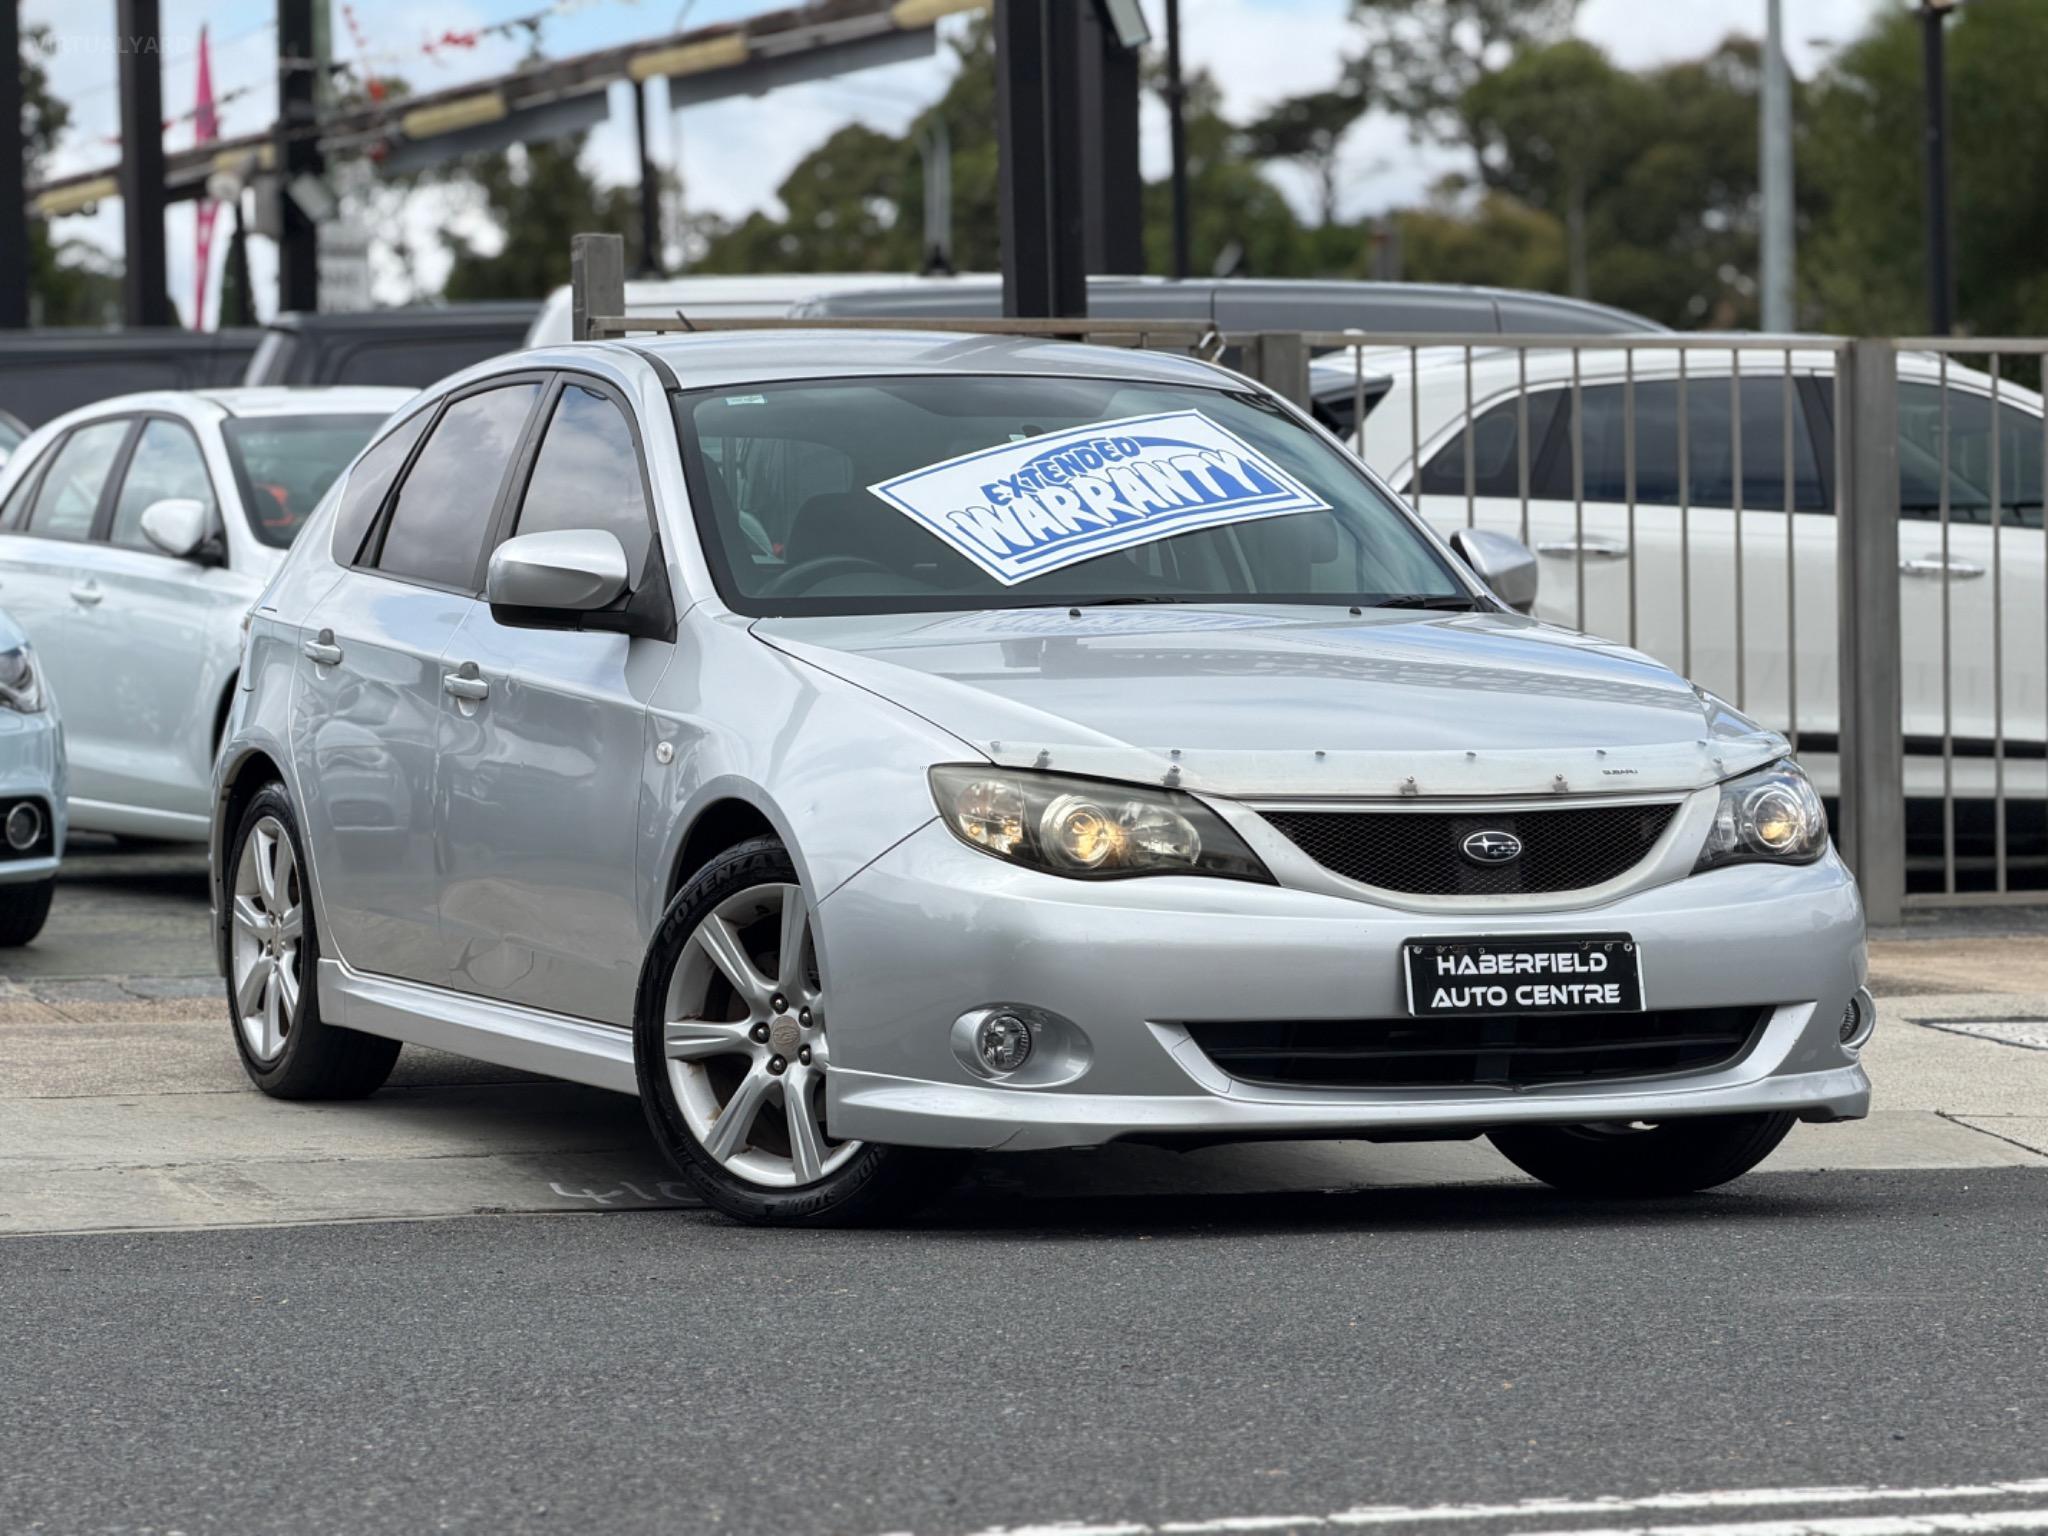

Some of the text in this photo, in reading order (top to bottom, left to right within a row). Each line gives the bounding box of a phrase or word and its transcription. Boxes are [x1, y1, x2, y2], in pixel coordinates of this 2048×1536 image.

[947, 449, 1264, 556] WARRANTY
[979, 435, 1142, 506] EXTENDED
[663, 854, 777, 944] POTENZA
[1431, 983, 1621, 1008] AUTO CENTRE
[1436, 953, 1608, 976] HABERFIELD
